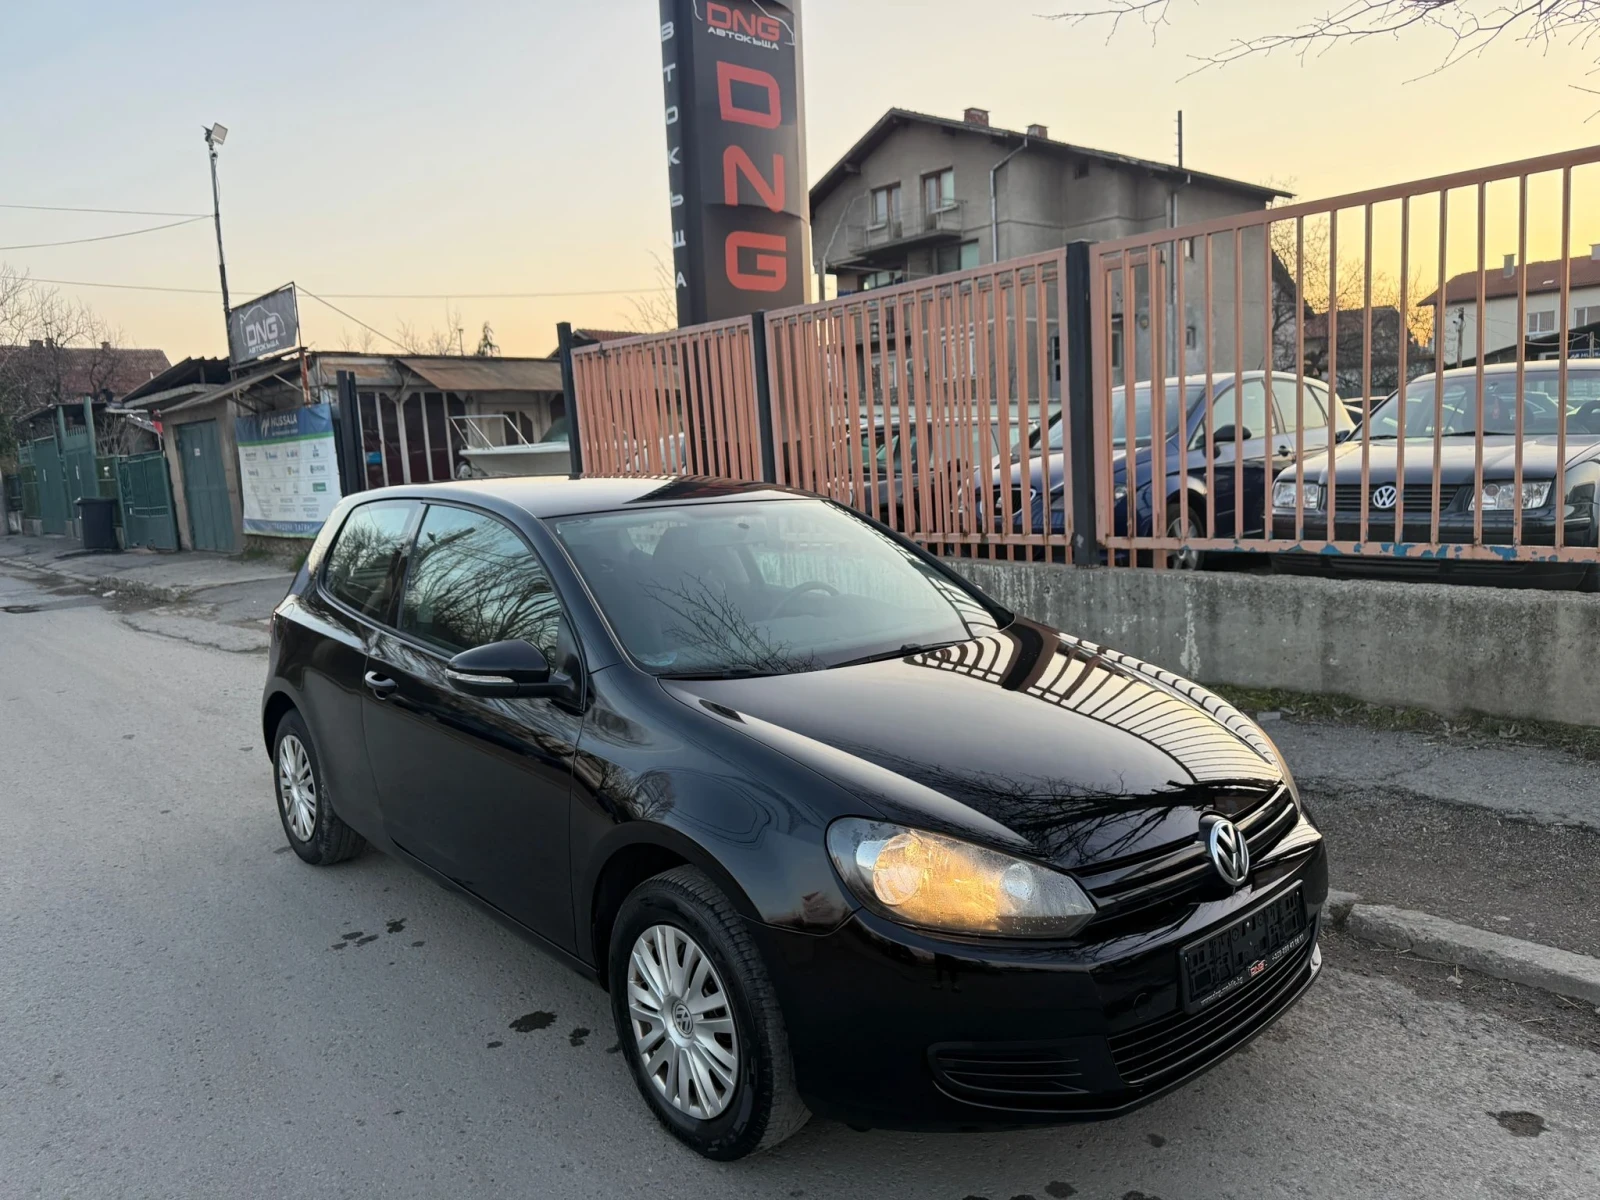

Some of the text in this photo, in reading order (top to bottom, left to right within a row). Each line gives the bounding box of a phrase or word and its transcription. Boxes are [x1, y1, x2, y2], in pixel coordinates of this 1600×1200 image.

[706, 1, 780, 41] DNG
[245, 316, 279, 347] DNG
[270, 413, 298, 428] MUSSALA
